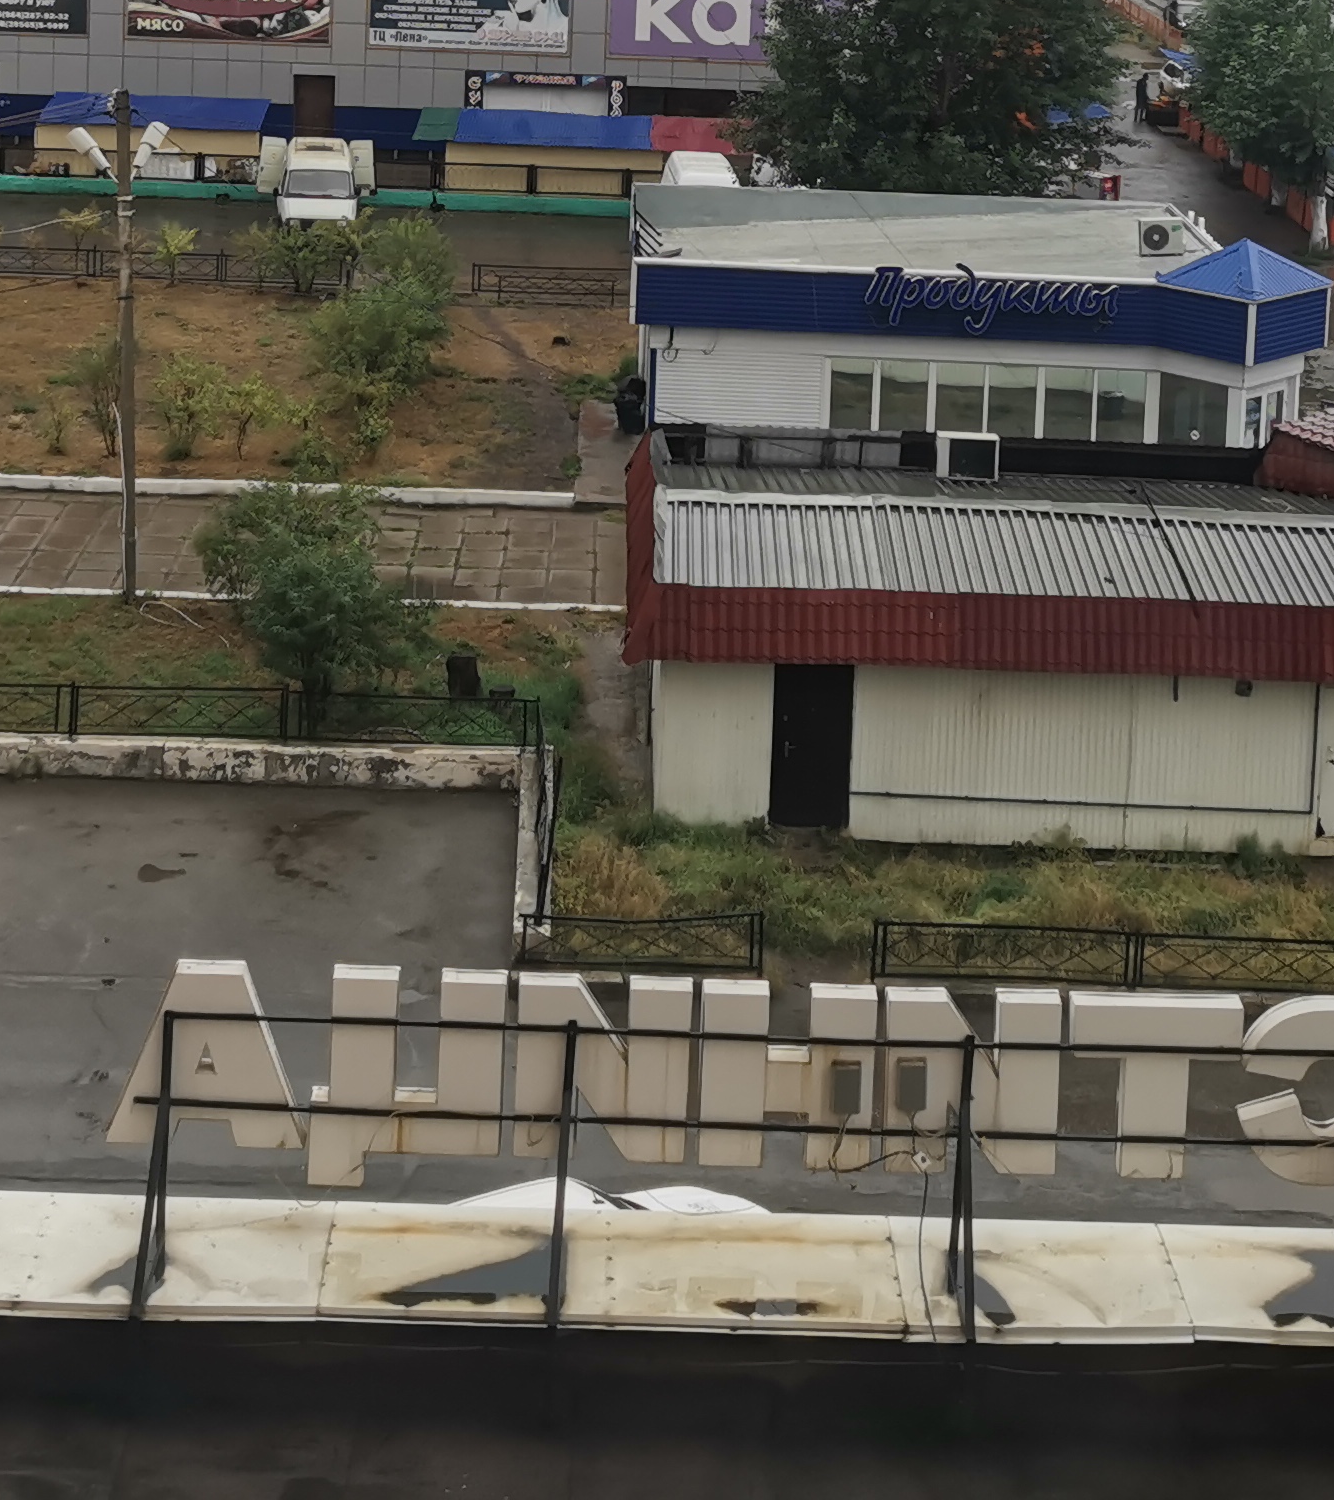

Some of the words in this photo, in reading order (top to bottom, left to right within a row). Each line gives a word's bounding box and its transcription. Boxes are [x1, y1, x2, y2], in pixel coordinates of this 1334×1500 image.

[136, 17, 185, 33] МЯСО
[373, 31, 386, 42] ТЦ
[864, 263, 1120, 335] Продукты
